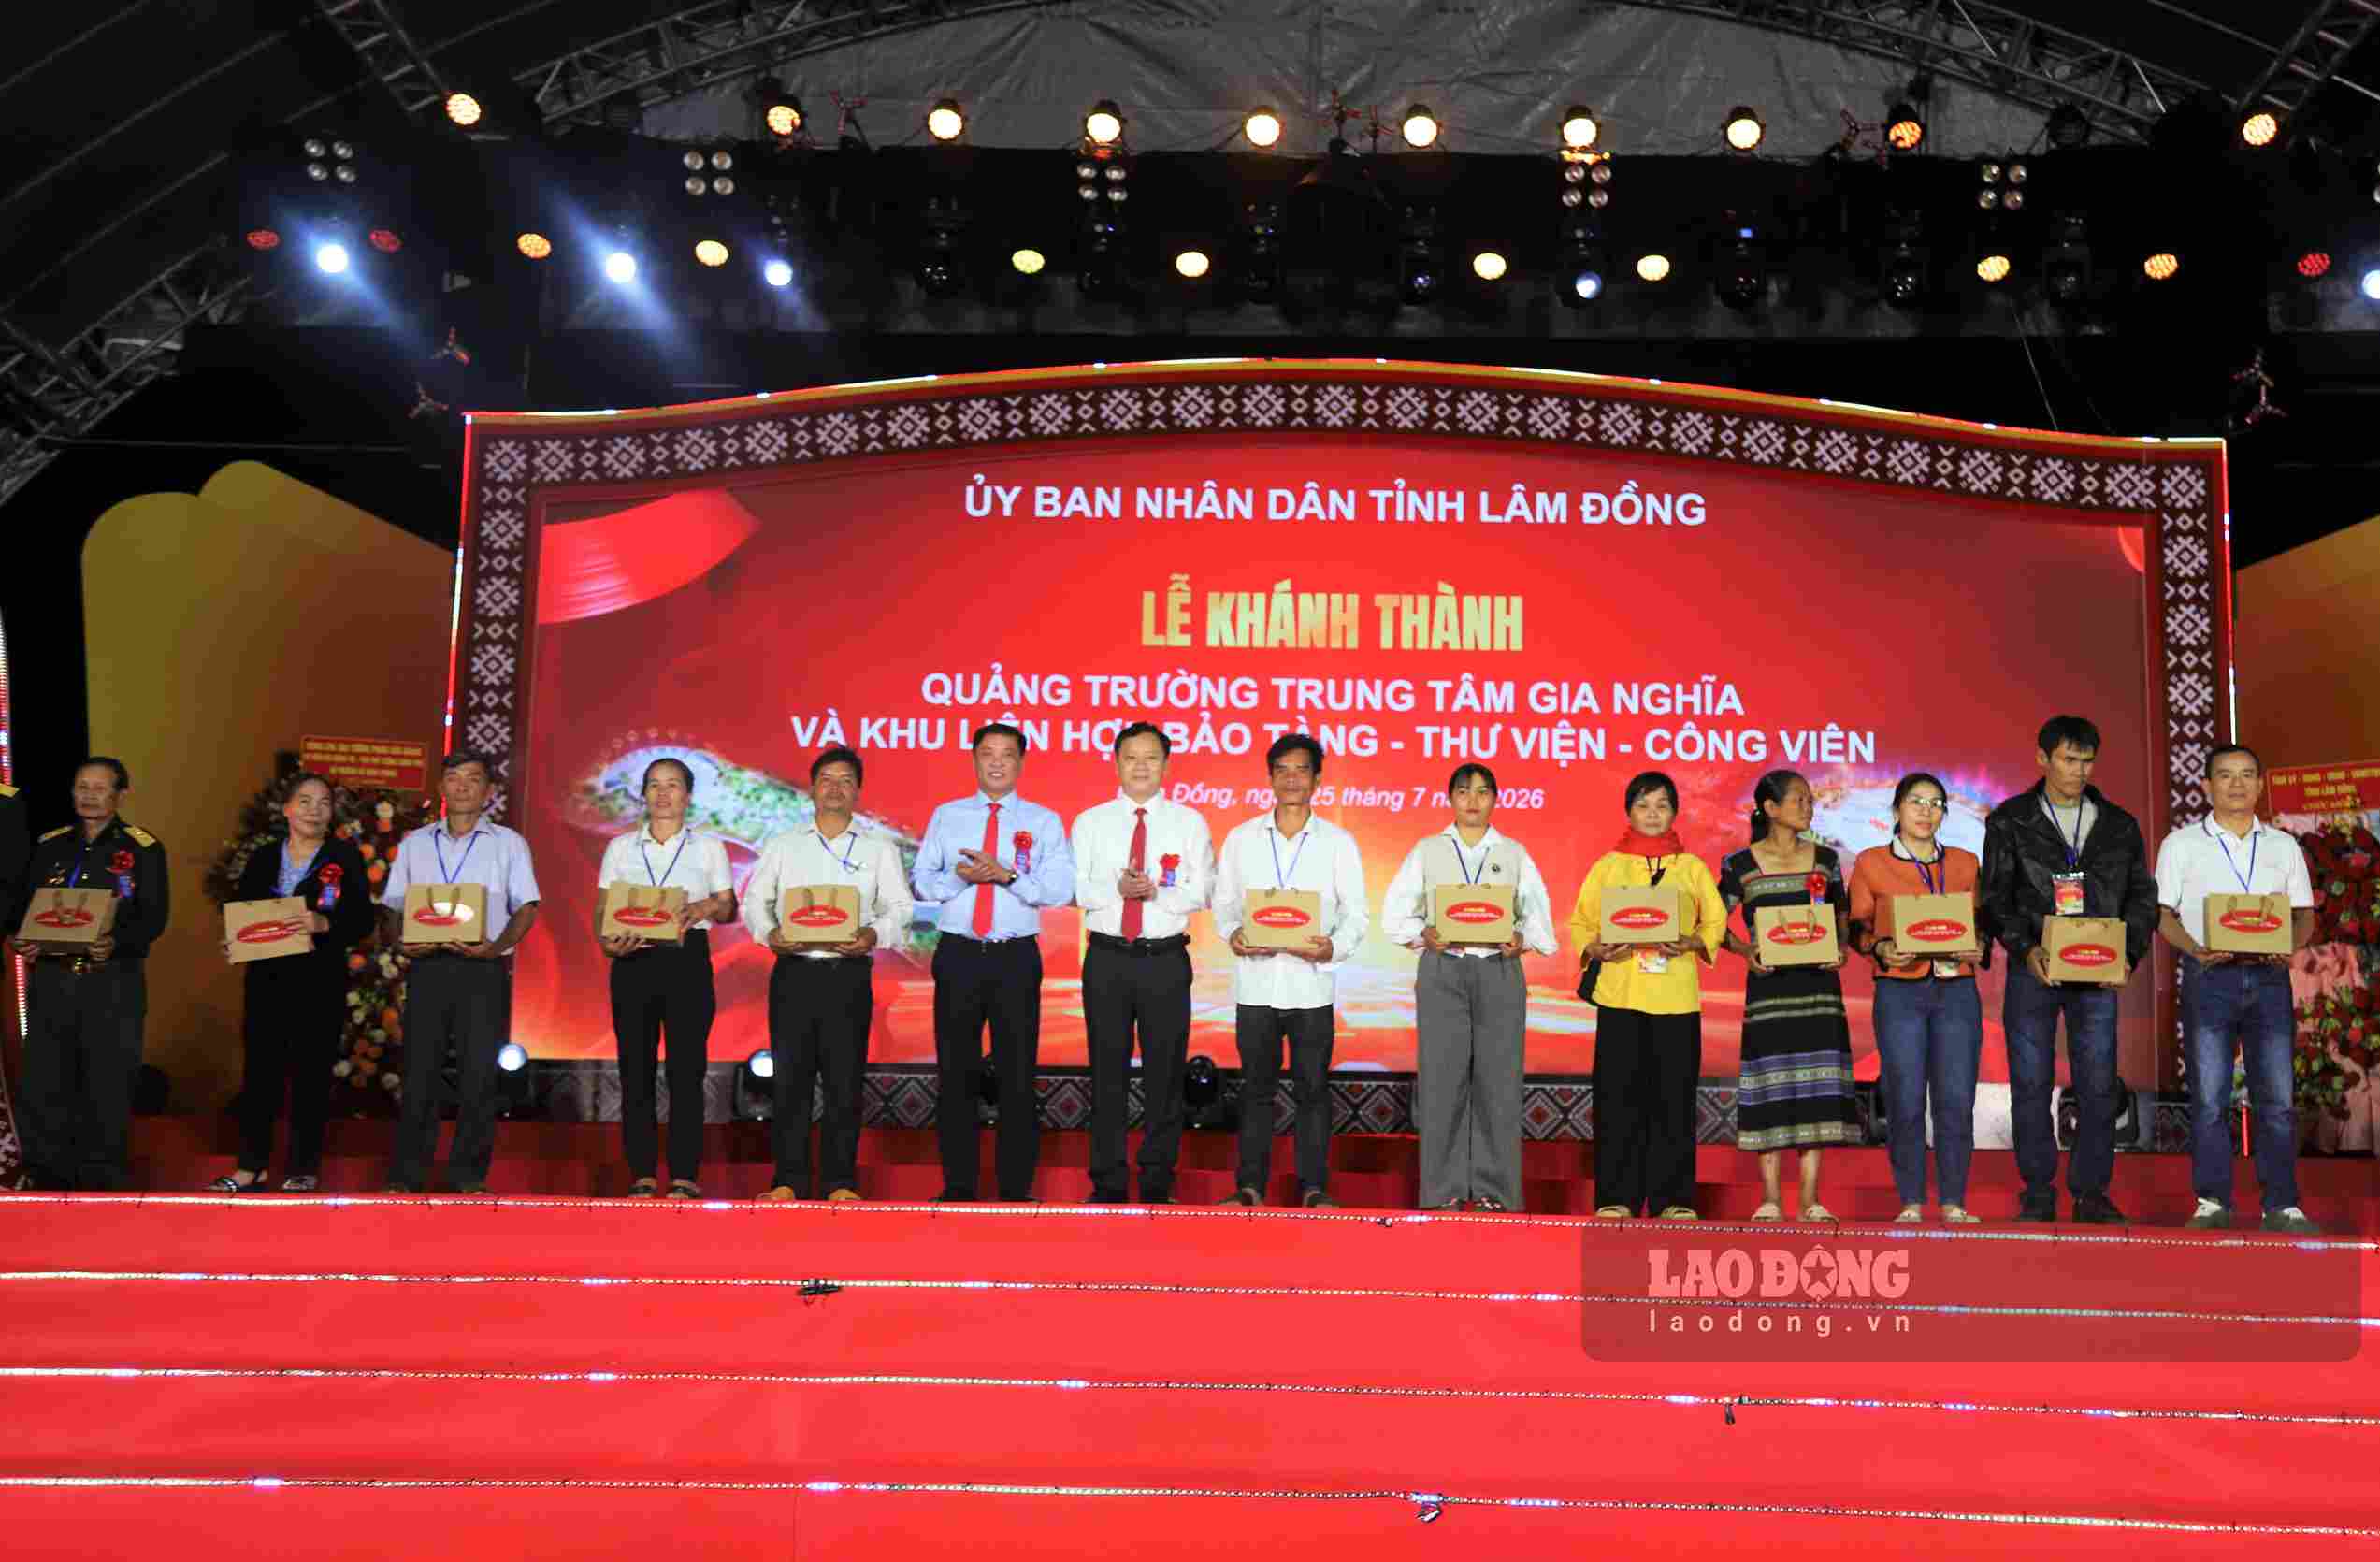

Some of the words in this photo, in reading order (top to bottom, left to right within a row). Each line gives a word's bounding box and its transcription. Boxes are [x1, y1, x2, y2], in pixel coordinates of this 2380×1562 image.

[966, 474, 1021, 517] ỦY
[1035, 486, 1121, 519] BAN
[1137, 480, 1254, 520] NHÂN
[1268, 482, 1356, 521] DÂN
[1369, 478, 1464, 523] TỈNH
[1479, 484, 1567, 524] LÂM
[1580, 479, 1707, 526] ĐỒNG
[1141, 574, 1191, 647] LỄ
[1206, 579, 1360, 650] KHÁNH
[1375, 581, 1523, 652] THÀNH
[921, 662, 1071, 706] QUẢNG
[1084, 668, 1259, 708] TRƯỜNG
[1272, 677, 1415, 711] TRUNG
[1427, 673, 1515, 713] TÂM
[1528, 681, 1602, 715] GIA
[1614, 675, 1745, 716] NGHĨA
[791, 708, 847, 748] VÀ
[860, 717, 945, 749] KHU
[959, 711, 1050, 751] LN
[1062, 718, 1133, 761] HỢ
[1163, 712, 1252, 755] BẢO
[1391, 740, 1404, 750] -
[1416, 723, 1503, 759] THƯ
[1511, 720, 1606, 768] VIỆN
[1619, 744, 1632, 753] -
[1644, 721, 1767, 763] CÔNG
[1779, 722, 1876, 764] VIÊN
[1309, 785, 1336, 807] 25
[1341, 786, 1406, 813] tháng
[1412, 787, 1427, 808] 7
